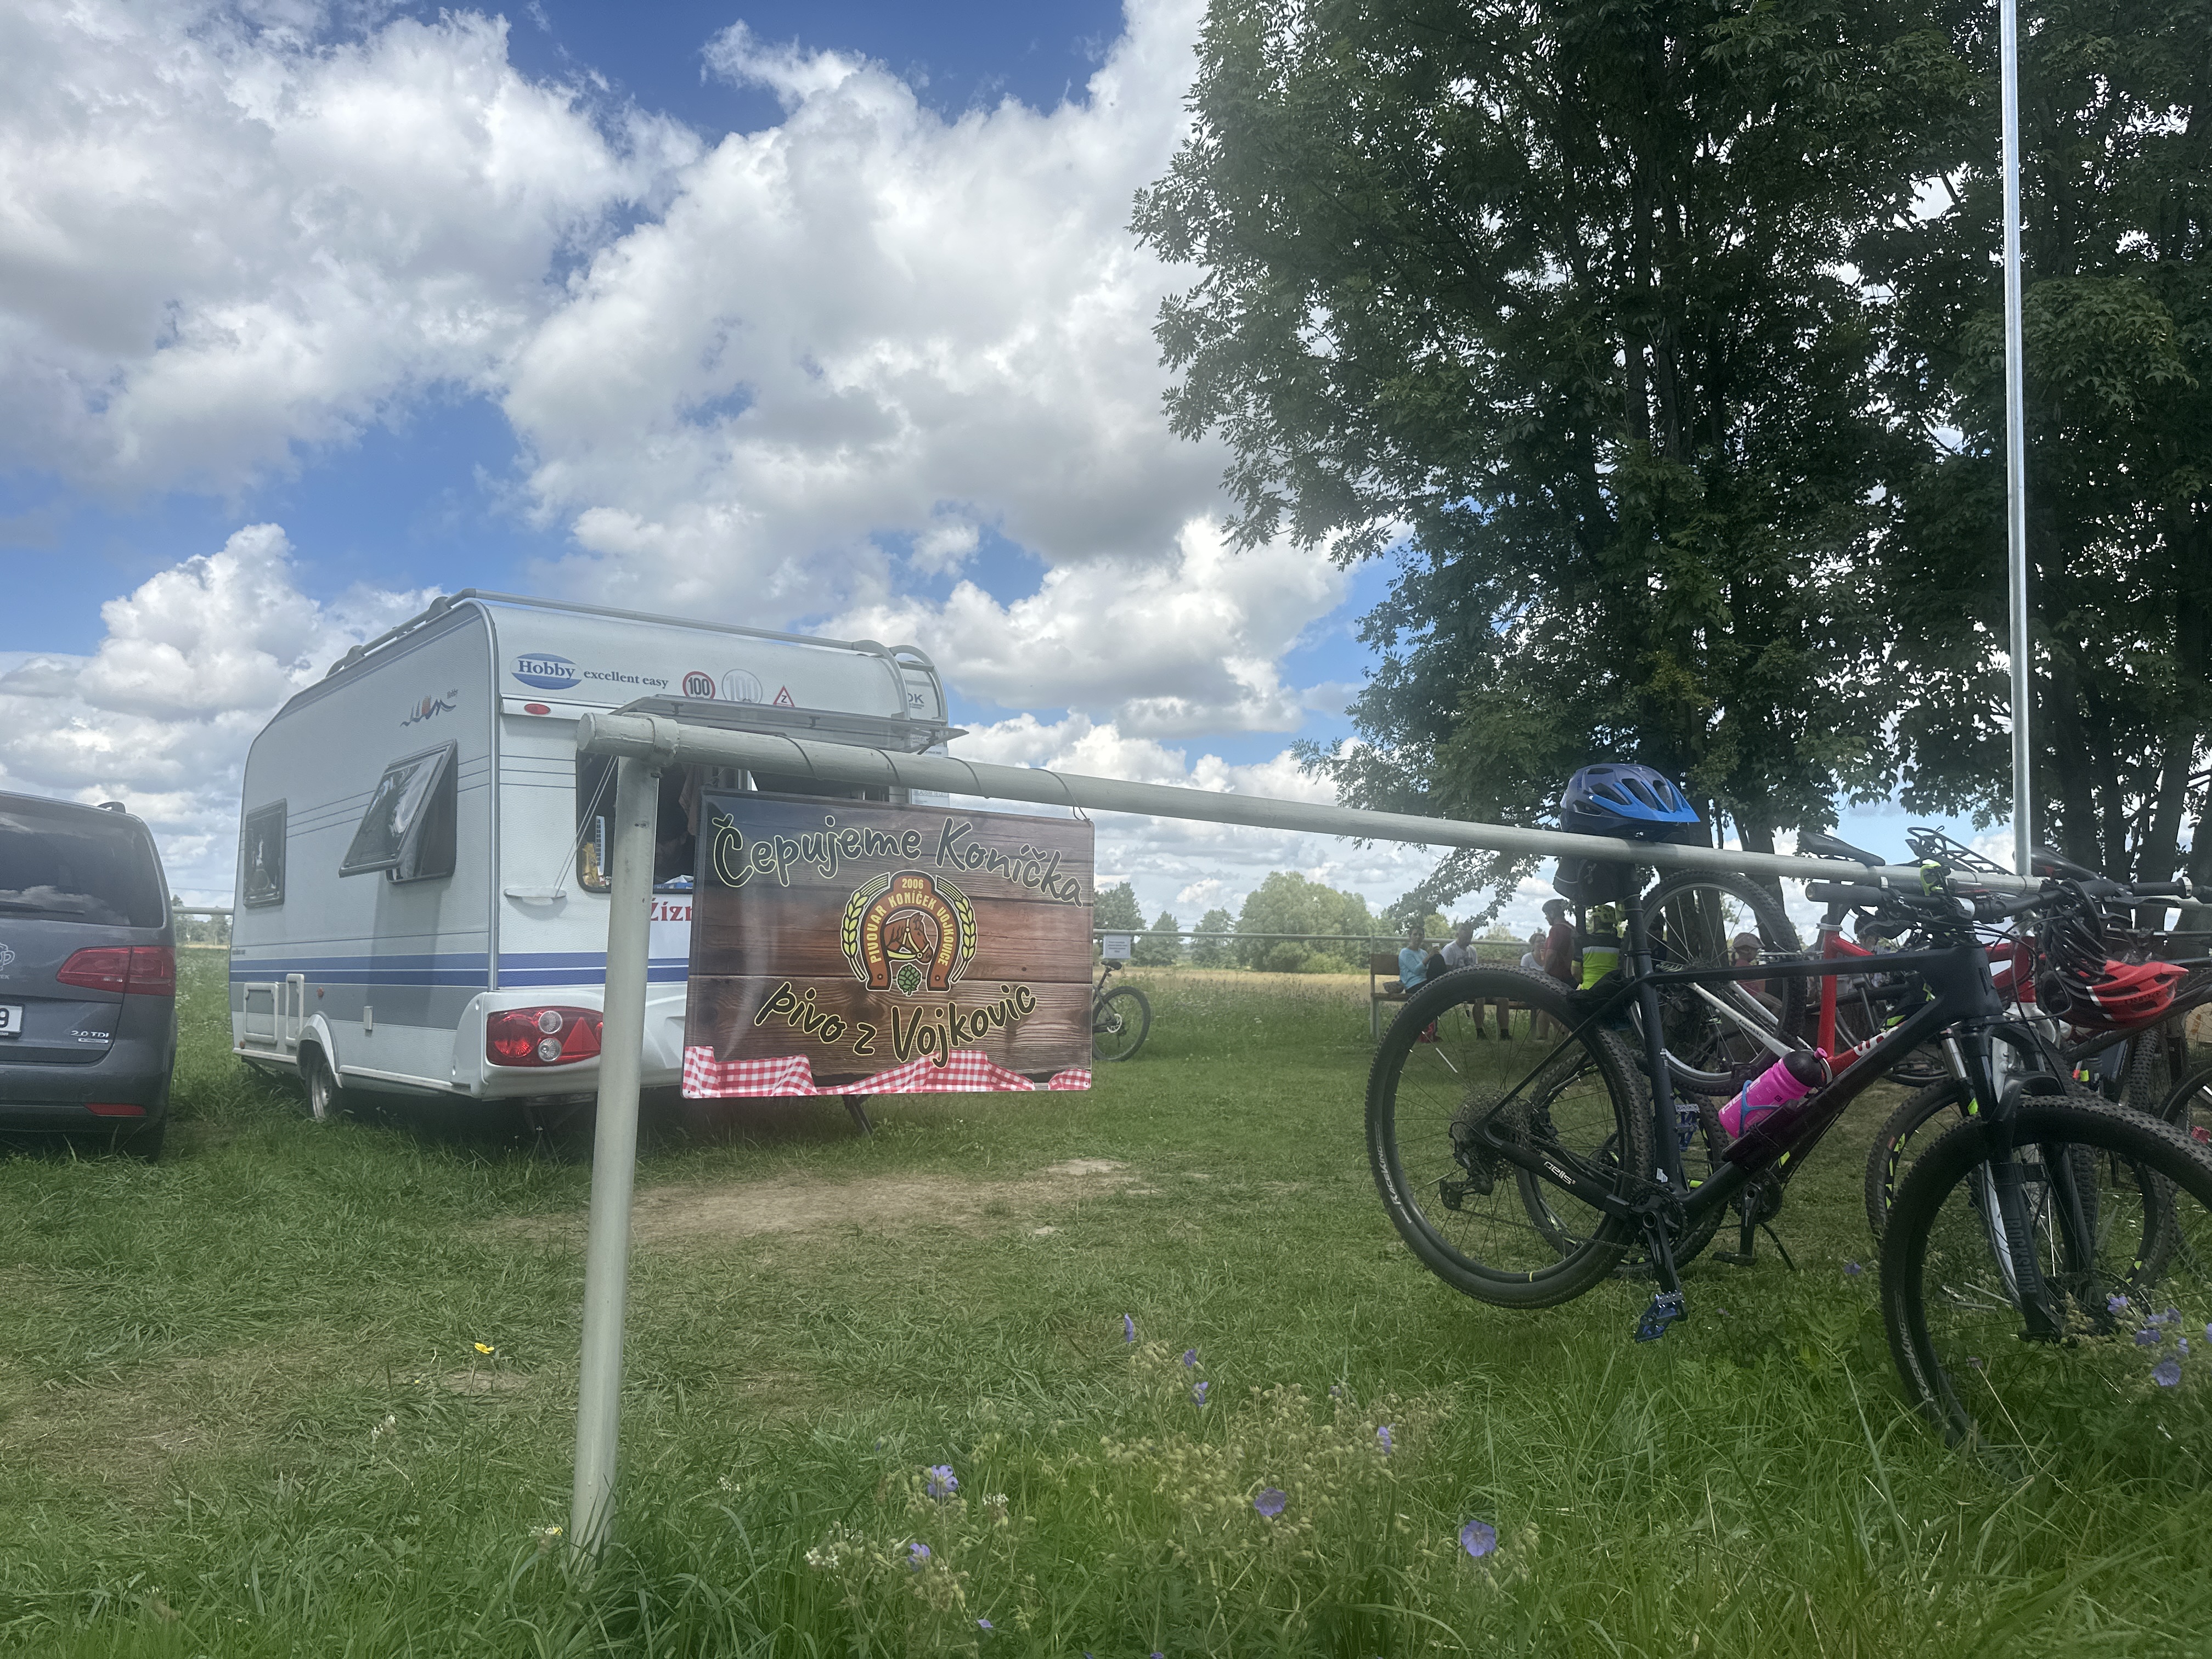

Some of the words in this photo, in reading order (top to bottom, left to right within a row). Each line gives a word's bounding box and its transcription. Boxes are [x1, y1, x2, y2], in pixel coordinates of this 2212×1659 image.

[518, 660, 575, 680] Hobby
[583, 670, 640, 684] excellent
[642, 678, 669, 689] easy
[688, 677, 710, 696] 100
[725, 675, 759, 703] 100
[781, 695, 788, 704] Z
[712, 813, 922, 888] Čepujeme
[936, 816, 1084, 908] Koníčka
[902, 878, 924, 889] 2006
[866, 905, 888, 964] PIVOVAR
[888, 890, 937, 911] KONÍČEK
[936, 906, 955, 967] VOJKOVICE
[754, 981, 848, 1045] pivo
[853, 1022, 878, 1056] z
[891, 984, 1037, 1069] Vojkovic
